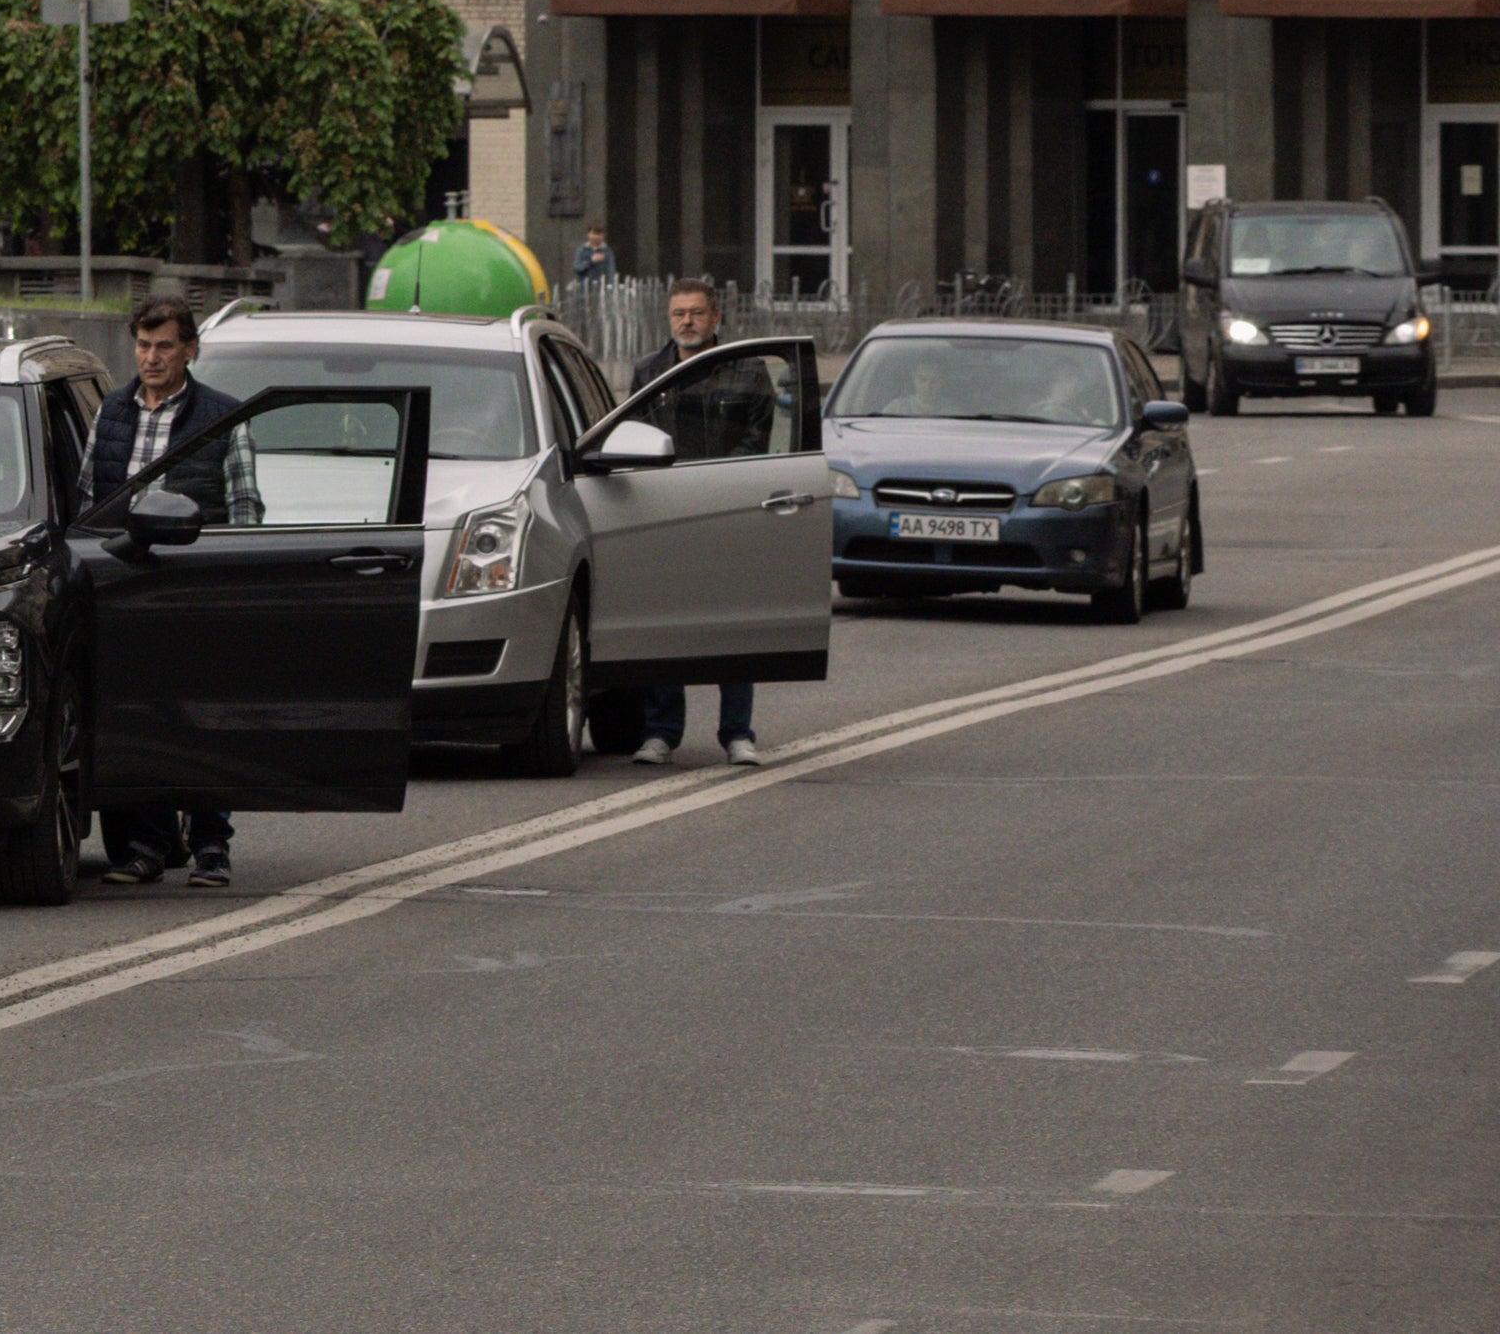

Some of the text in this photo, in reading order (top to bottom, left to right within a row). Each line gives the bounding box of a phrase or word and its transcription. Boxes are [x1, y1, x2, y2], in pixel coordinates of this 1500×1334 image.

[901, 518, 992, 537] AA 9498 TX
